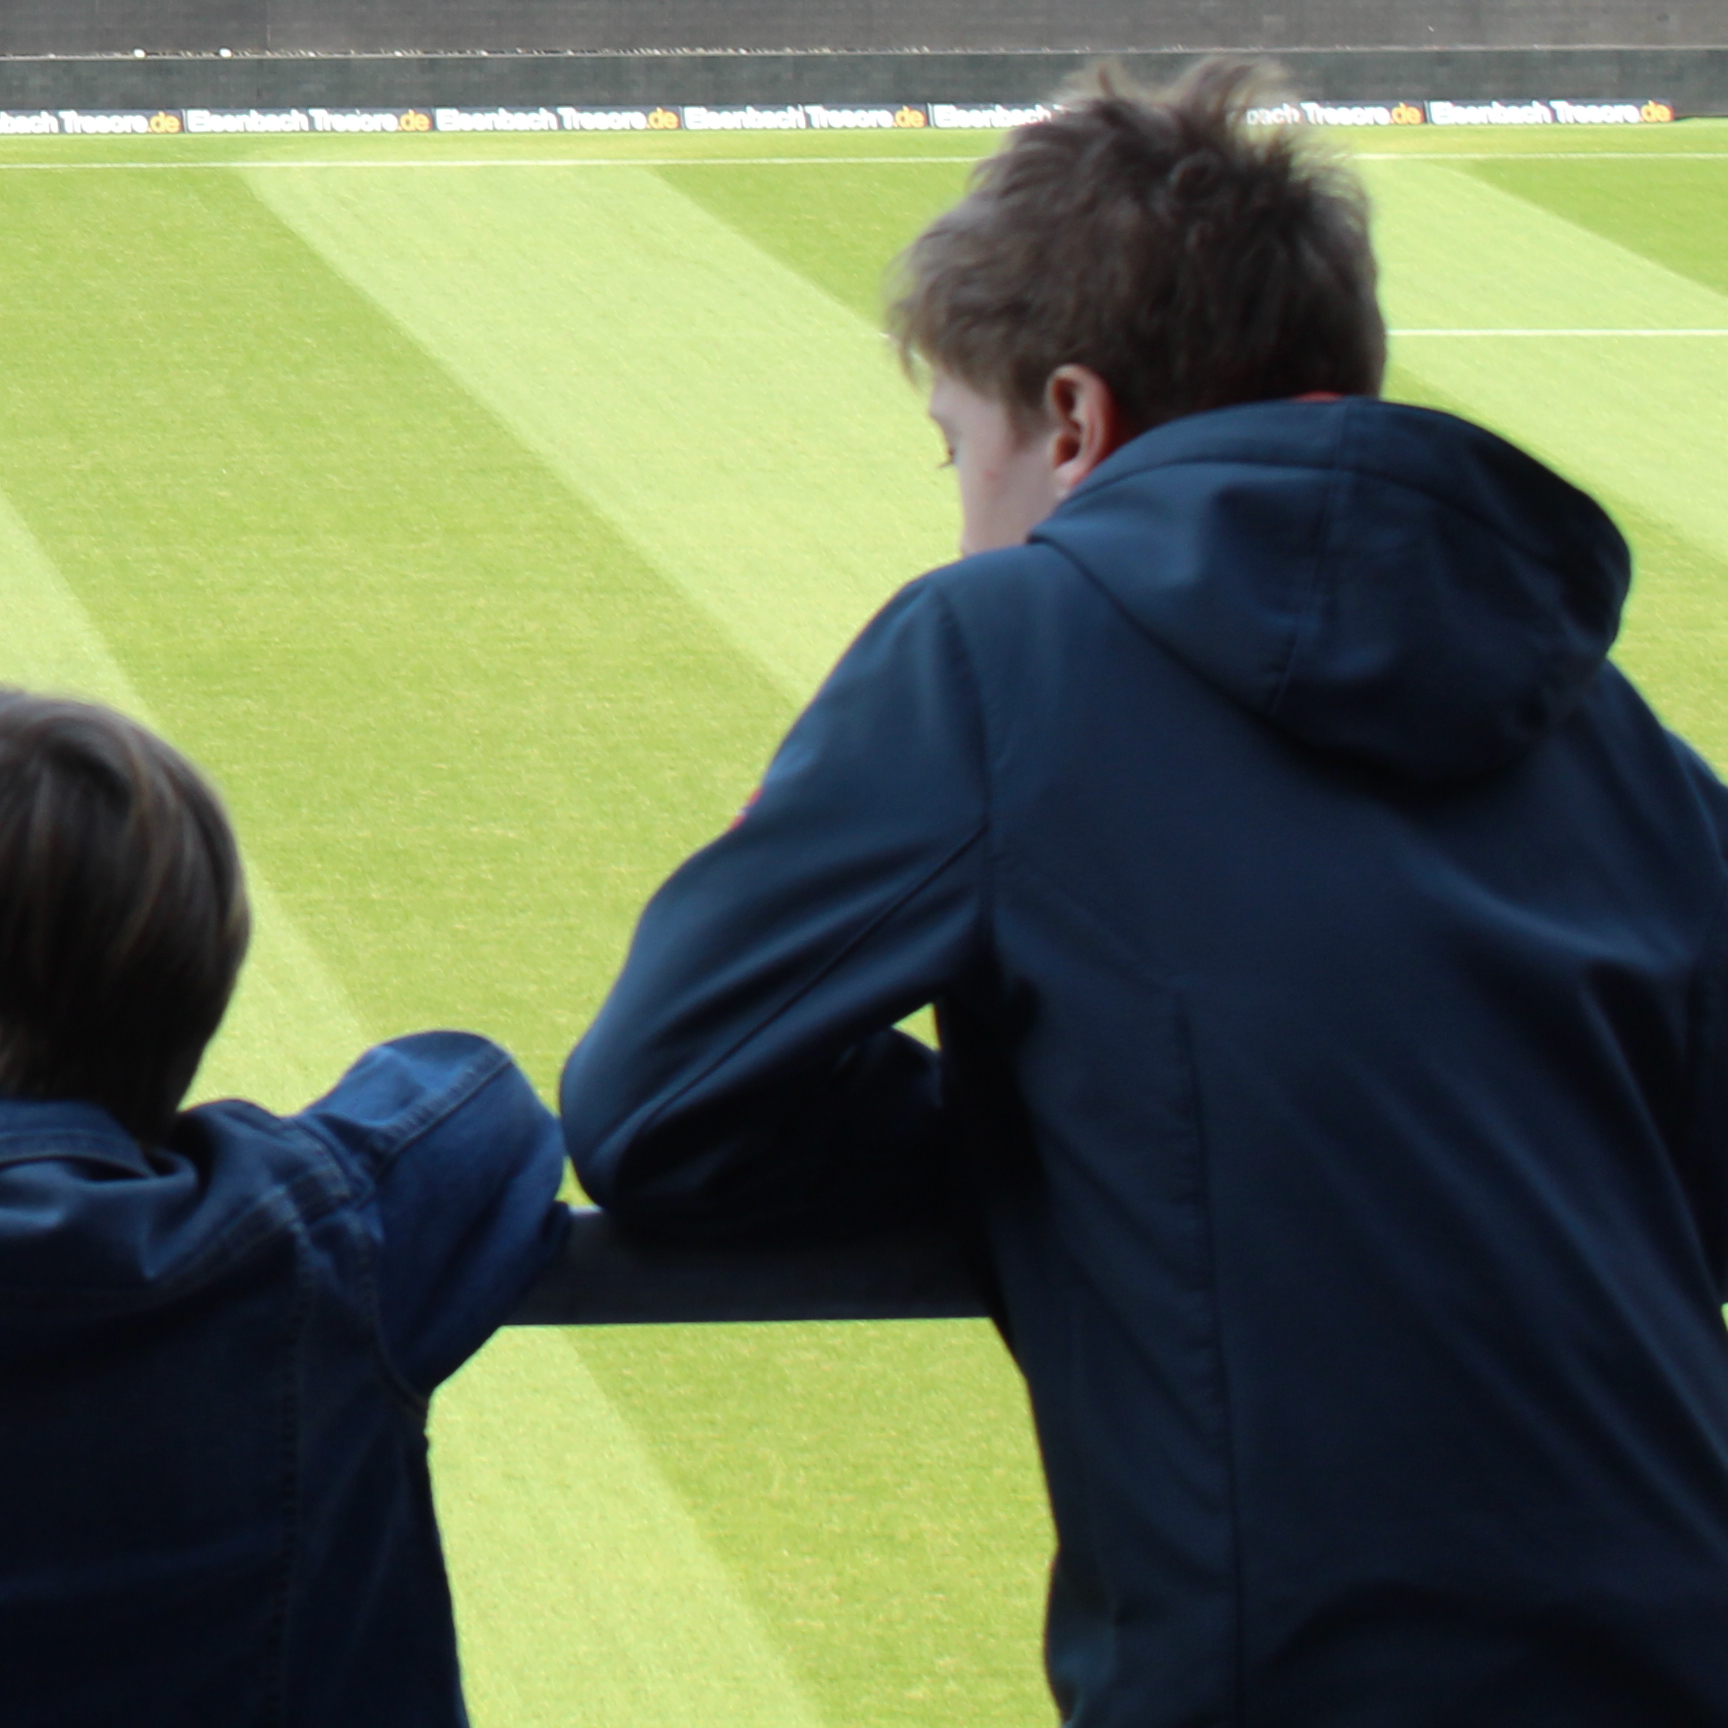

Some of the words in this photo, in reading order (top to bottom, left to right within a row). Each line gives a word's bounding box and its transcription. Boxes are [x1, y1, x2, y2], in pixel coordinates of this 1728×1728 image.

[60, 111, 181, 134] Tresore.de
[313, 109, 430, 132] Tresore.de
[559, 107, 680, 131] Tresore.de
[808, 104, 927, 129] Tresore.de
[1551, 100, 1673, 124] Tresore.de
